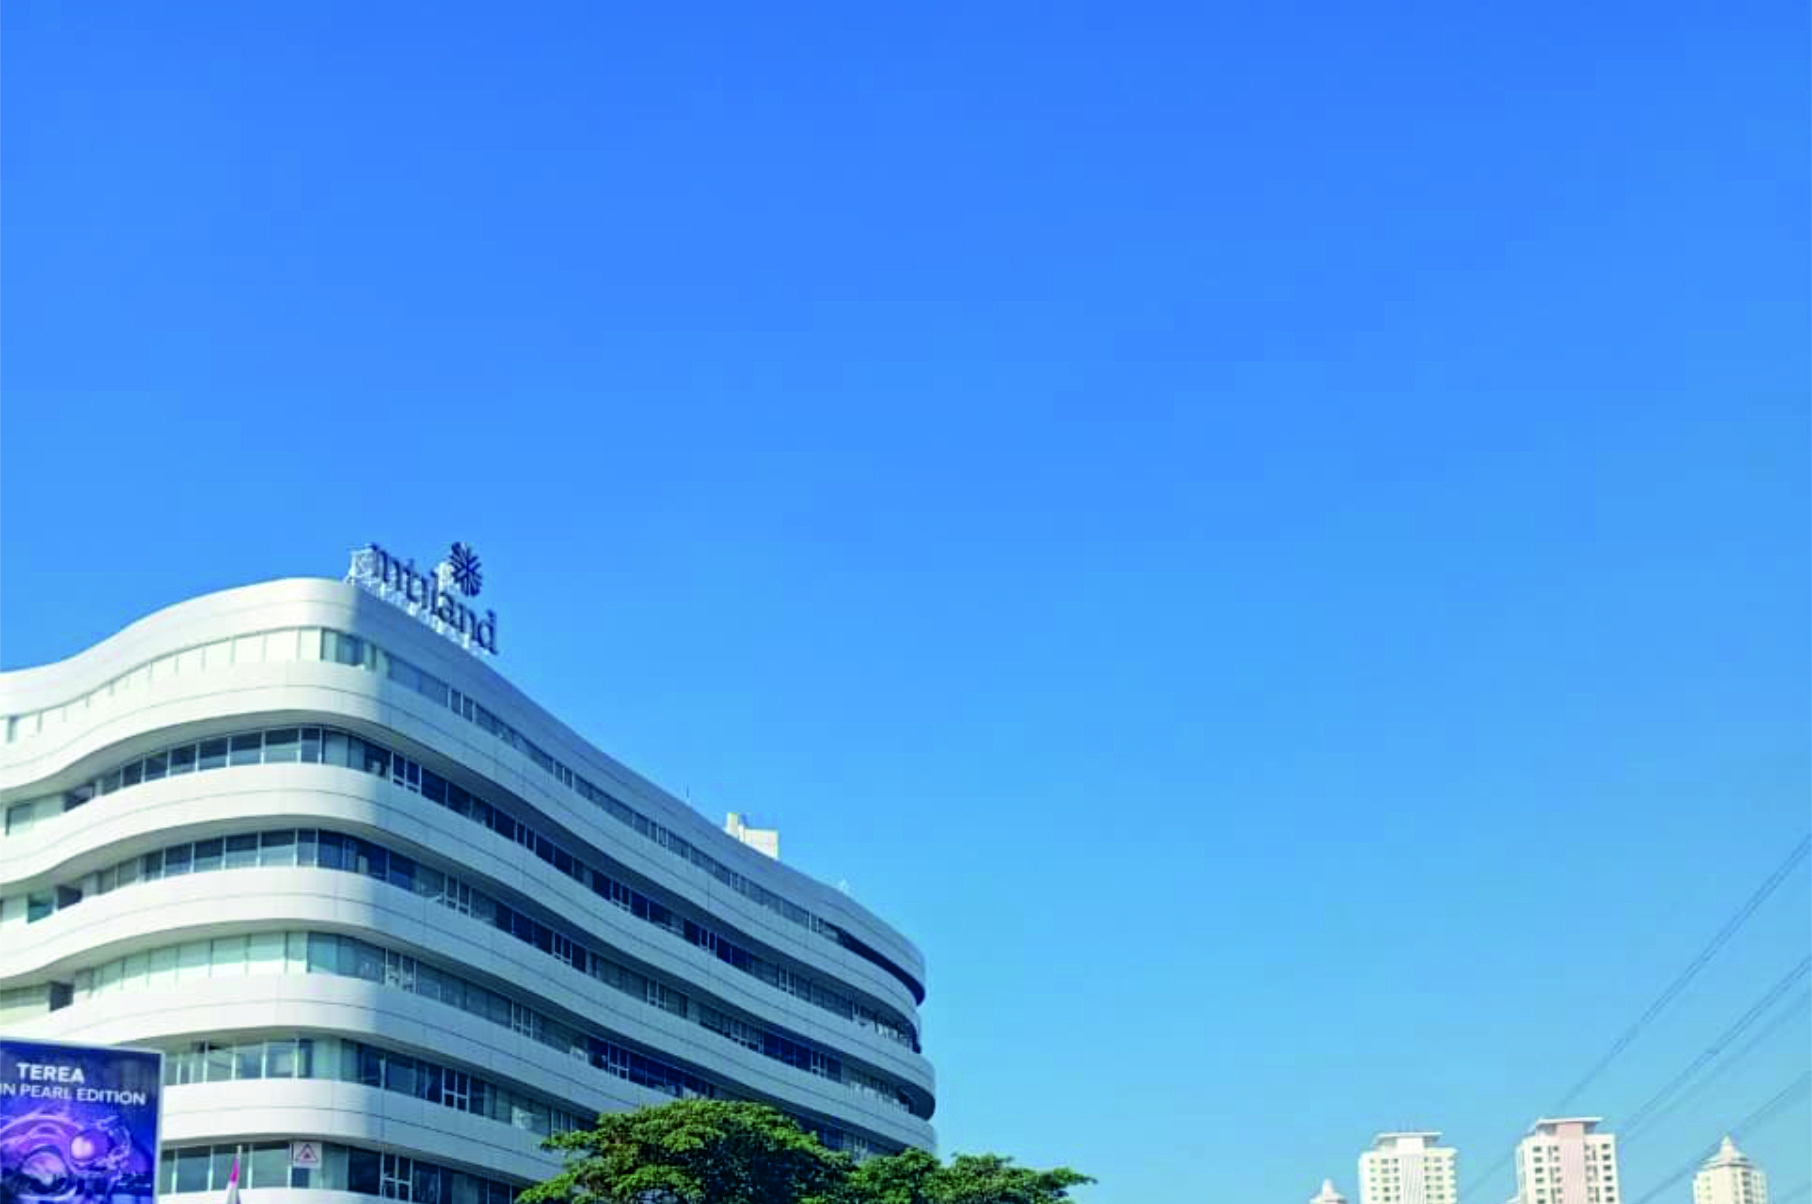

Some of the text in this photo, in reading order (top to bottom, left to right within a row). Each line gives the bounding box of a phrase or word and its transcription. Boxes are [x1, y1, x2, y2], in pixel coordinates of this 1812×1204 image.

[16, 1062, 85, 1084] TEREA
[20, 1084, 72, 1100] PEARL
[77, 1088, 146, 1105] EDITION
